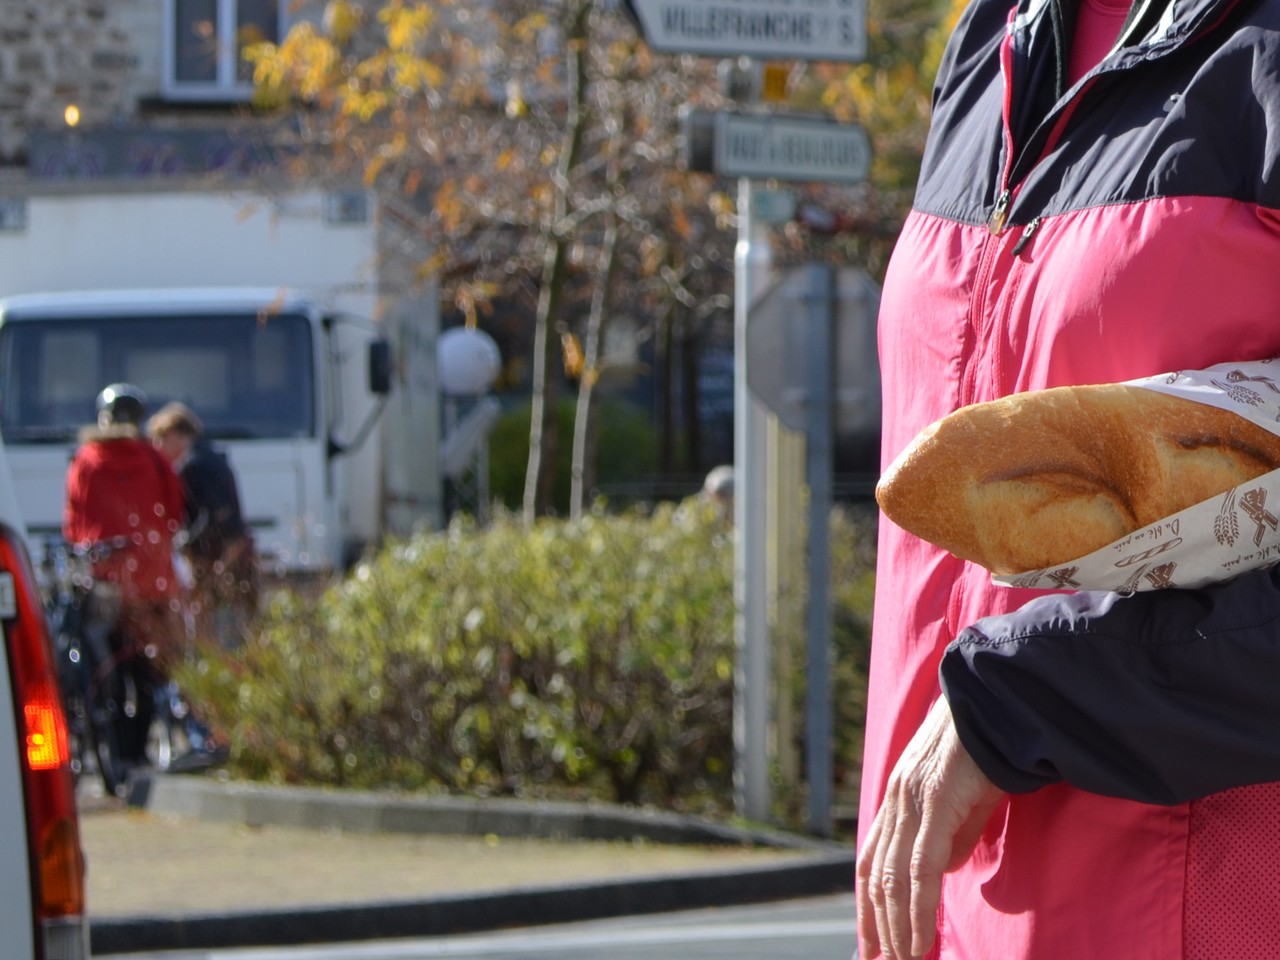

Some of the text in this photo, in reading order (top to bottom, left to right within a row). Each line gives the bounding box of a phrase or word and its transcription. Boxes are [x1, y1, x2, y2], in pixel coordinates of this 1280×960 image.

[1113, 518, 1180, 552] Du blé au pain
[1221, 554, 1242, 571] pain
